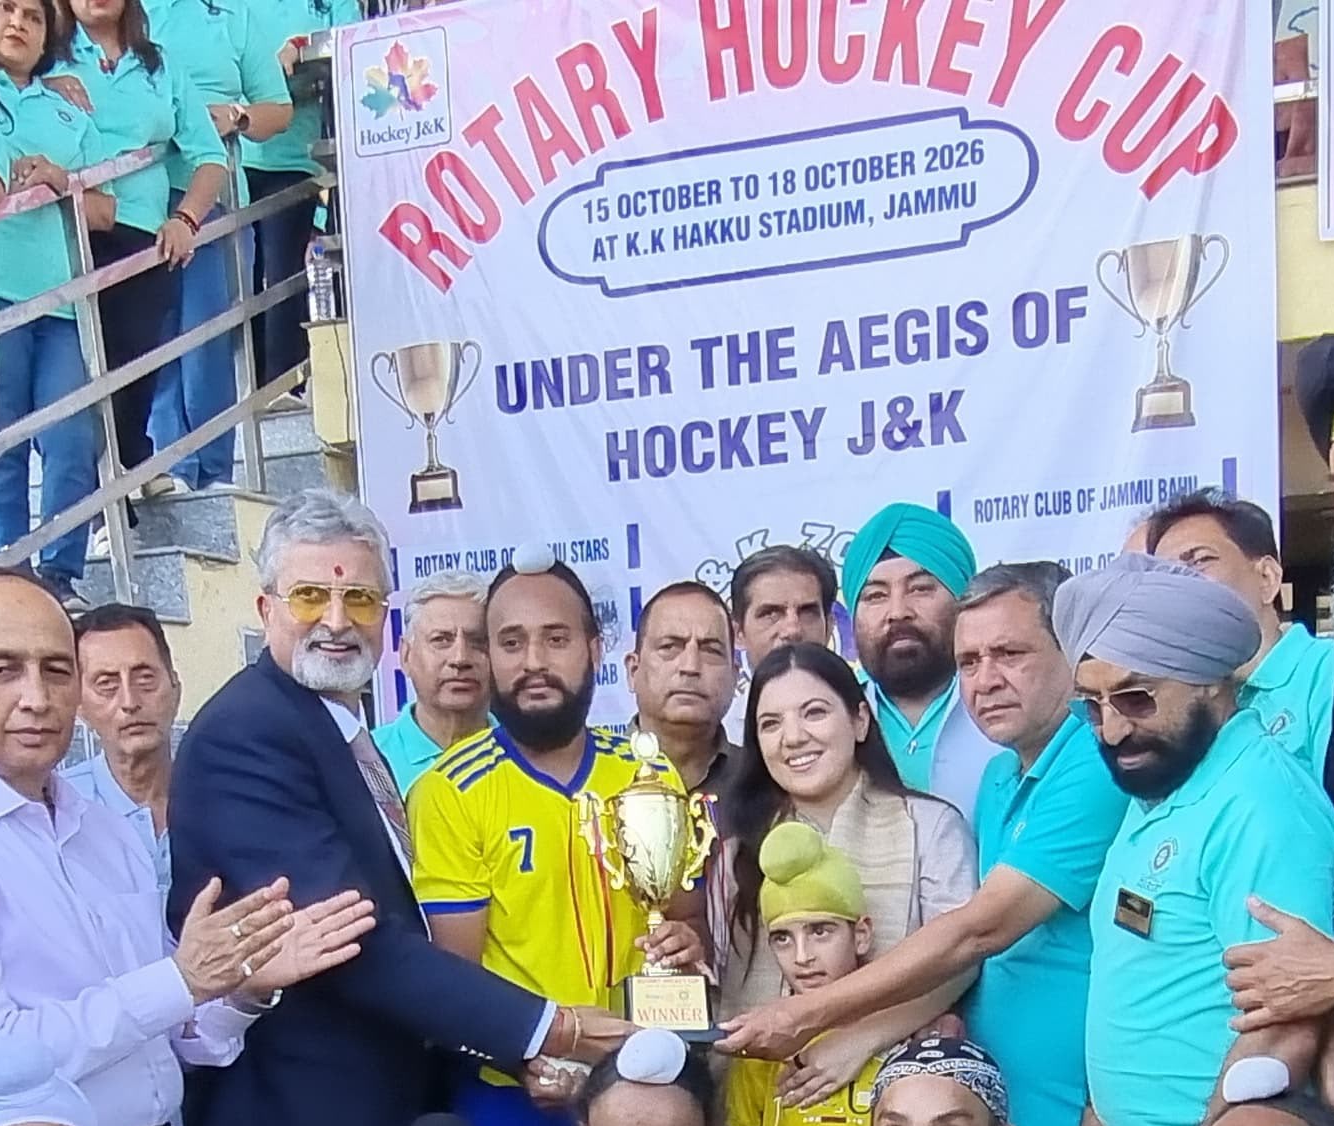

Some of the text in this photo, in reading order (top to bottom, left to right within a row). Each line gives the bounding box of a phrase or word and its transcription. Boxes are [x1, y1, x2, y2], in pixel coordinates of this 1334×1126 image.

[359, 116, 445, 147] Hockey J&K
[379, 0, 1238, 294] ROTARY HOCKEY CUP
[582, 139, 985, 224] 15 OCTOBER TO 18 OCTOBER 2026
[592, 181, 977, 262] AT K.K HAKKU STADIUM, JAMMU
[494, 286, 1089, 414] UNDER THE AEGIS OF
[605, 389, 967, 482] HOCKEY J&K
[974, 494, 1029, 523] ROTARY
[1035, 490, 1072, 517] CLUB
[1077, 488, 1096, 512] OF
[1099, 479, 1153, 510] JAMMU
[415, 551, 461, 578] ROTARY
[466, 548, 497, 572] CLUB
[571, 537, 609, 564] STARS
[508, 826, 535, 875] 7
[637, 1007, 702, 1022] WINNER
